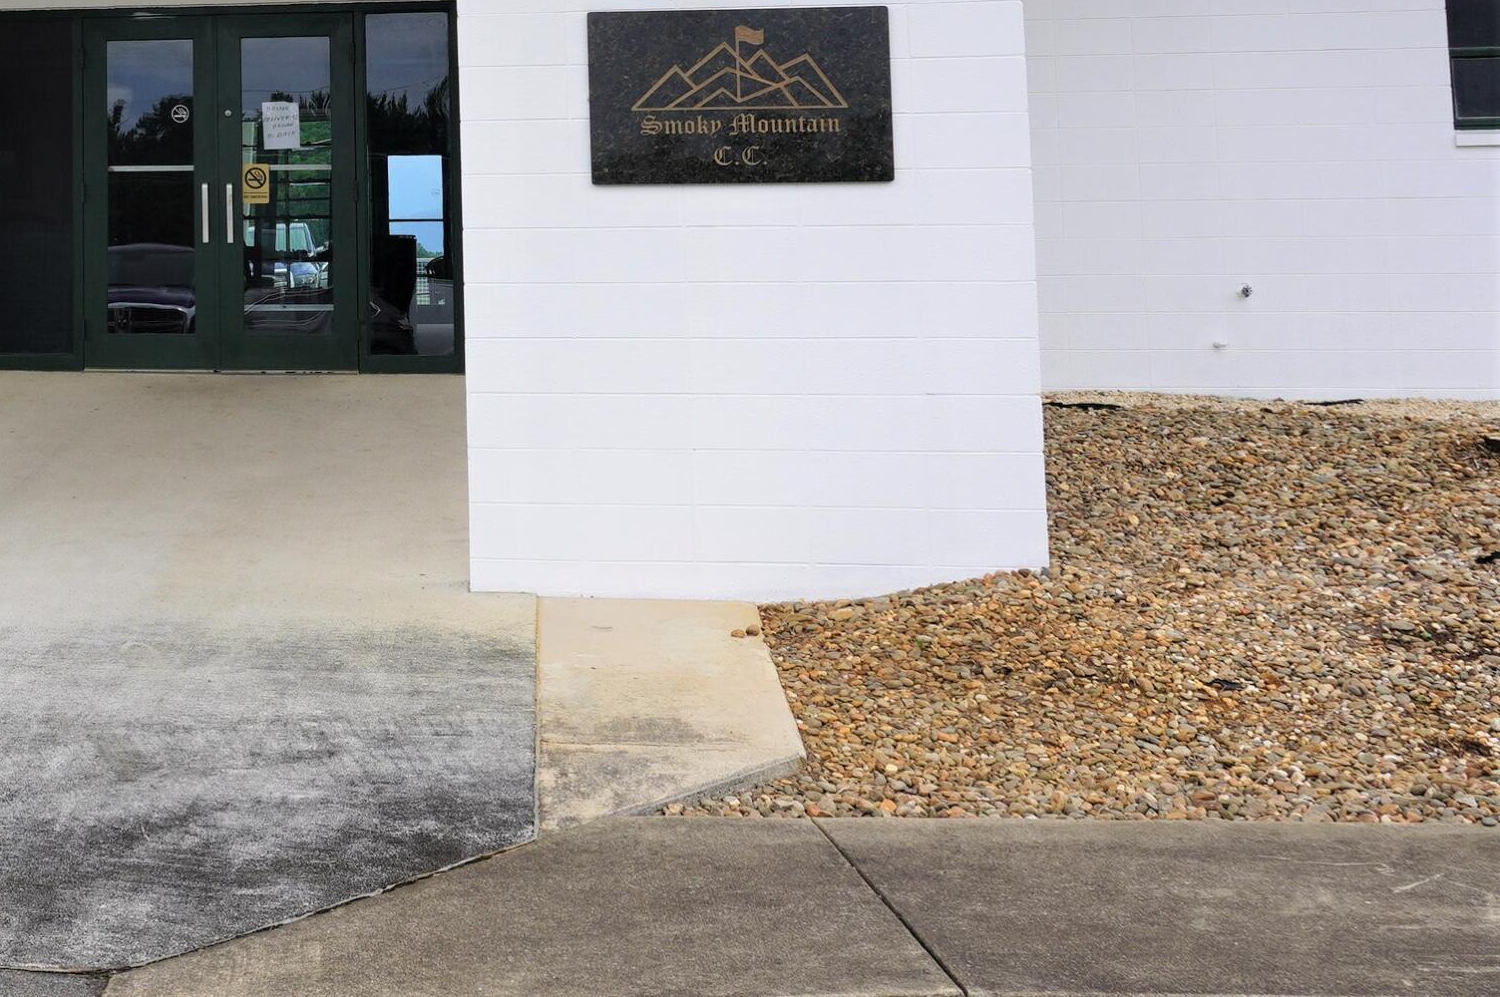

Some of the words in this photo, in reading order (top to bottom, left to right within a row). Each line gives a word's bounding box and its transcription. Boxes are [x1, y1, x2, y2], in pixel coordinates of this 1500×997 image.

[640, 115, 722, 137] Smoky
[729, 113, 841, 137] Mountain
[713, 145, 768, 166] C.C.
